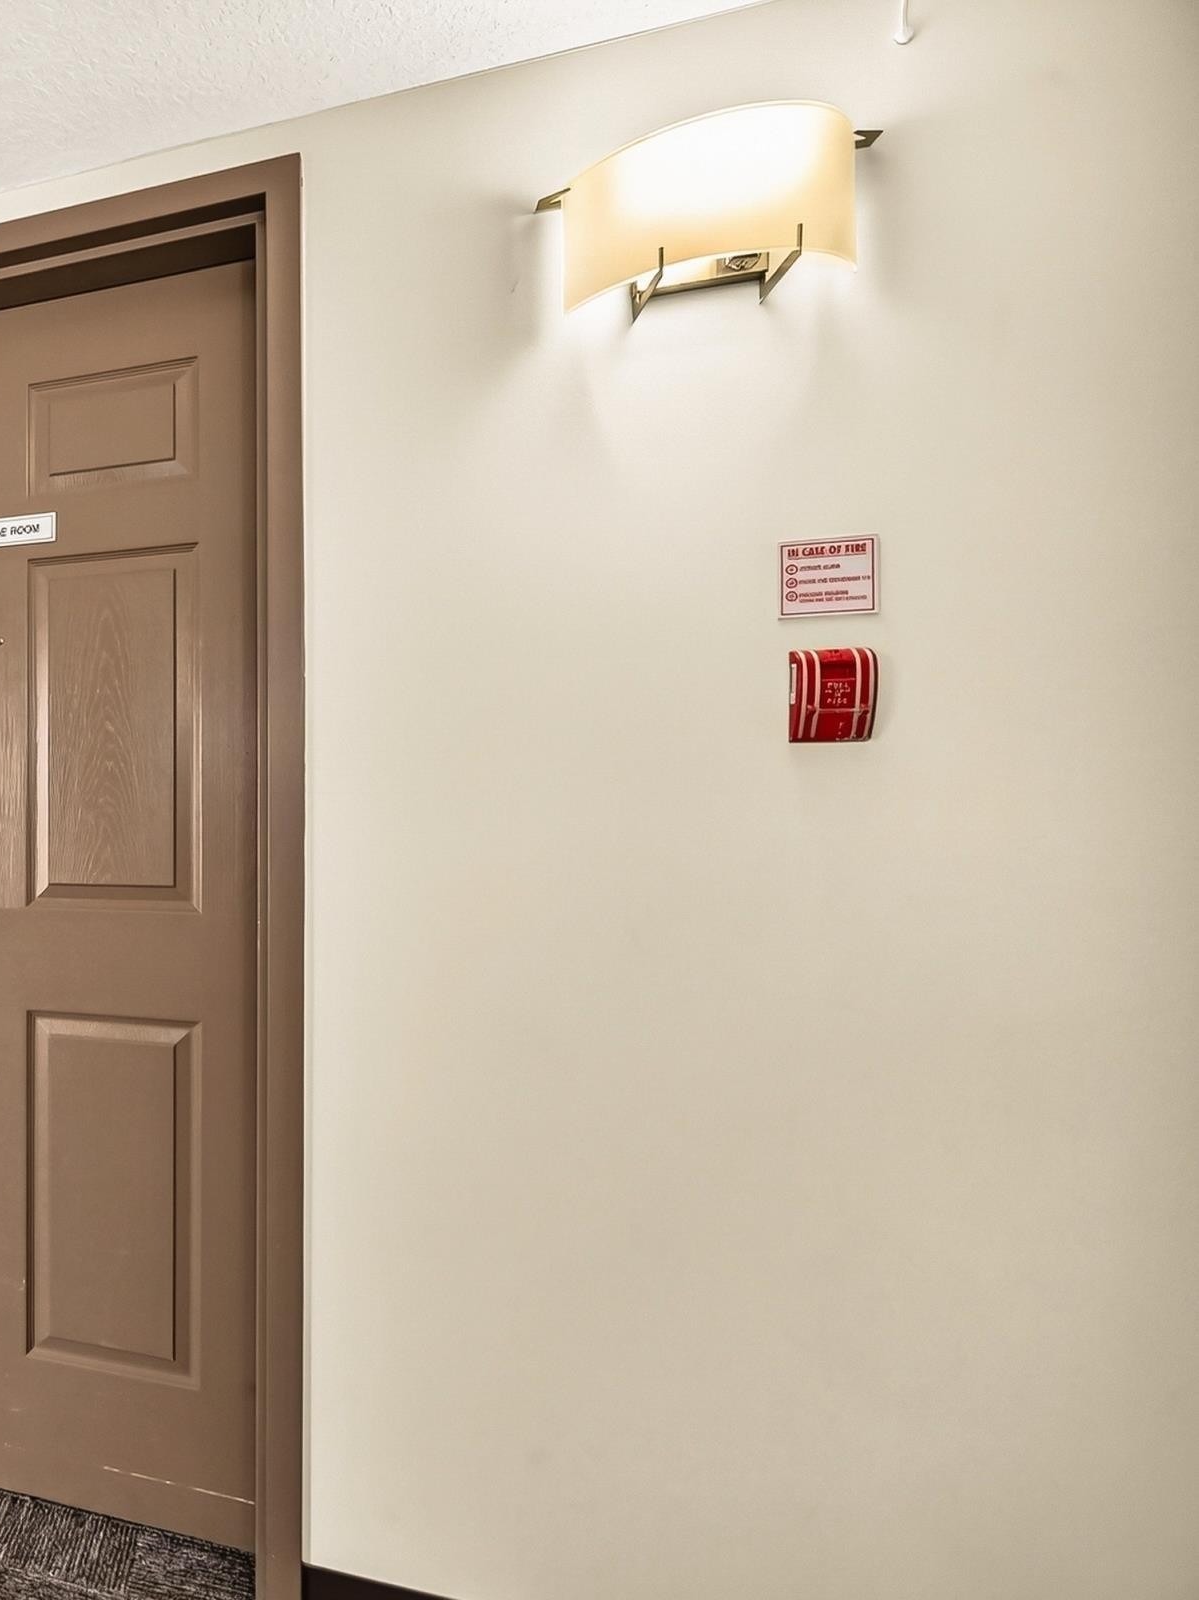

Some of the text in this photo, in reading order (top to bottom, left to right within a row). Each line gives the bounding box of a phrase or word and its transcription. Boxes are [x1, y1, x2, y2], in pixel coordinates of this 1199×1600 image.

[10, 523, 40, 535] ROOM
[787, 547, 799, 557] IN
[829, 545, 841, 555] OF
[845, 542, 867, 553] FIRE
